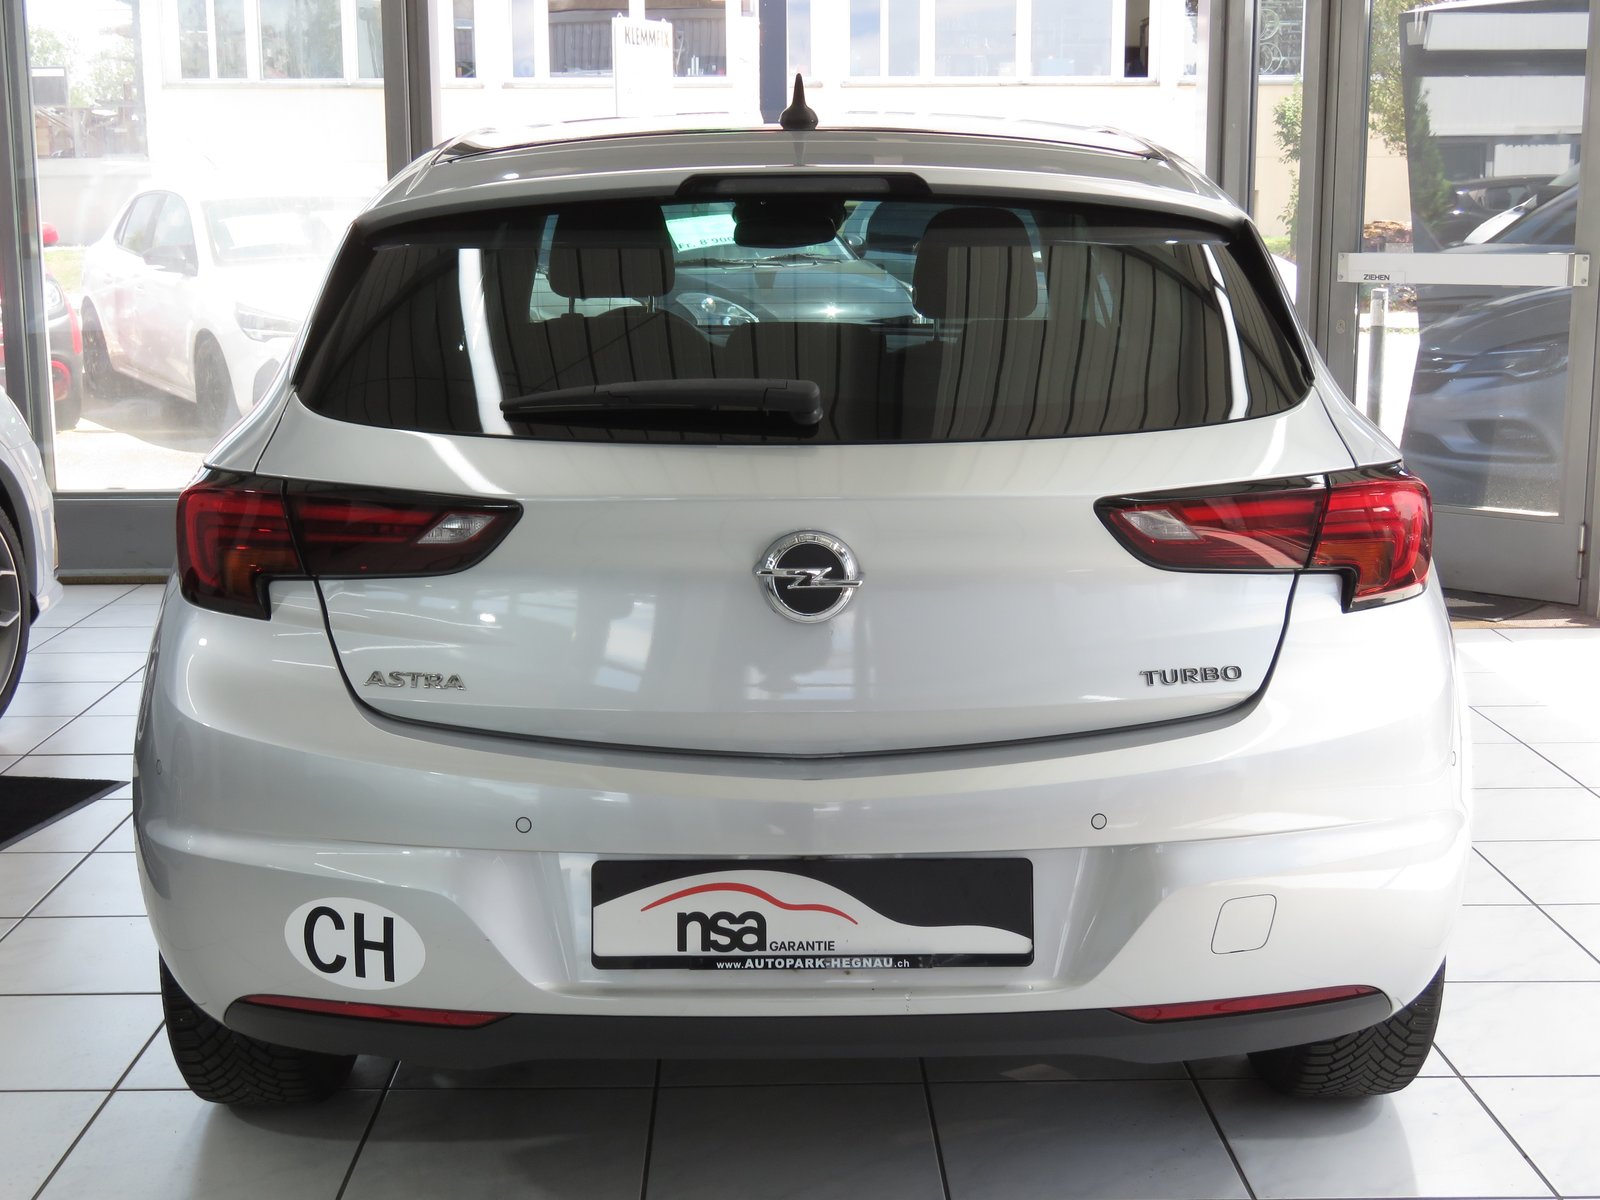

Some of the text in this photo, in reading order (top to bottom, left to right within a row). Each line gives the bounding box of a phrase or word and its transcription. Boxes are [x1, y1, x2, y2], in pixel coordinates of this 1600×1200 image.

[624, 26, 670, 48] KLEMMFIX
[1363, 273, 1390, 281] ZIEHEN
[363, 670, 466, 690] ASTRA
[1139, 665, 1242, 686] TURBO
[677, 911, 835, 952] nsa GARANTIE
[303, 906, 395, 982] CH
[716, 957, 910, 970] www.AUTOPARK-HEGNAU.ch
